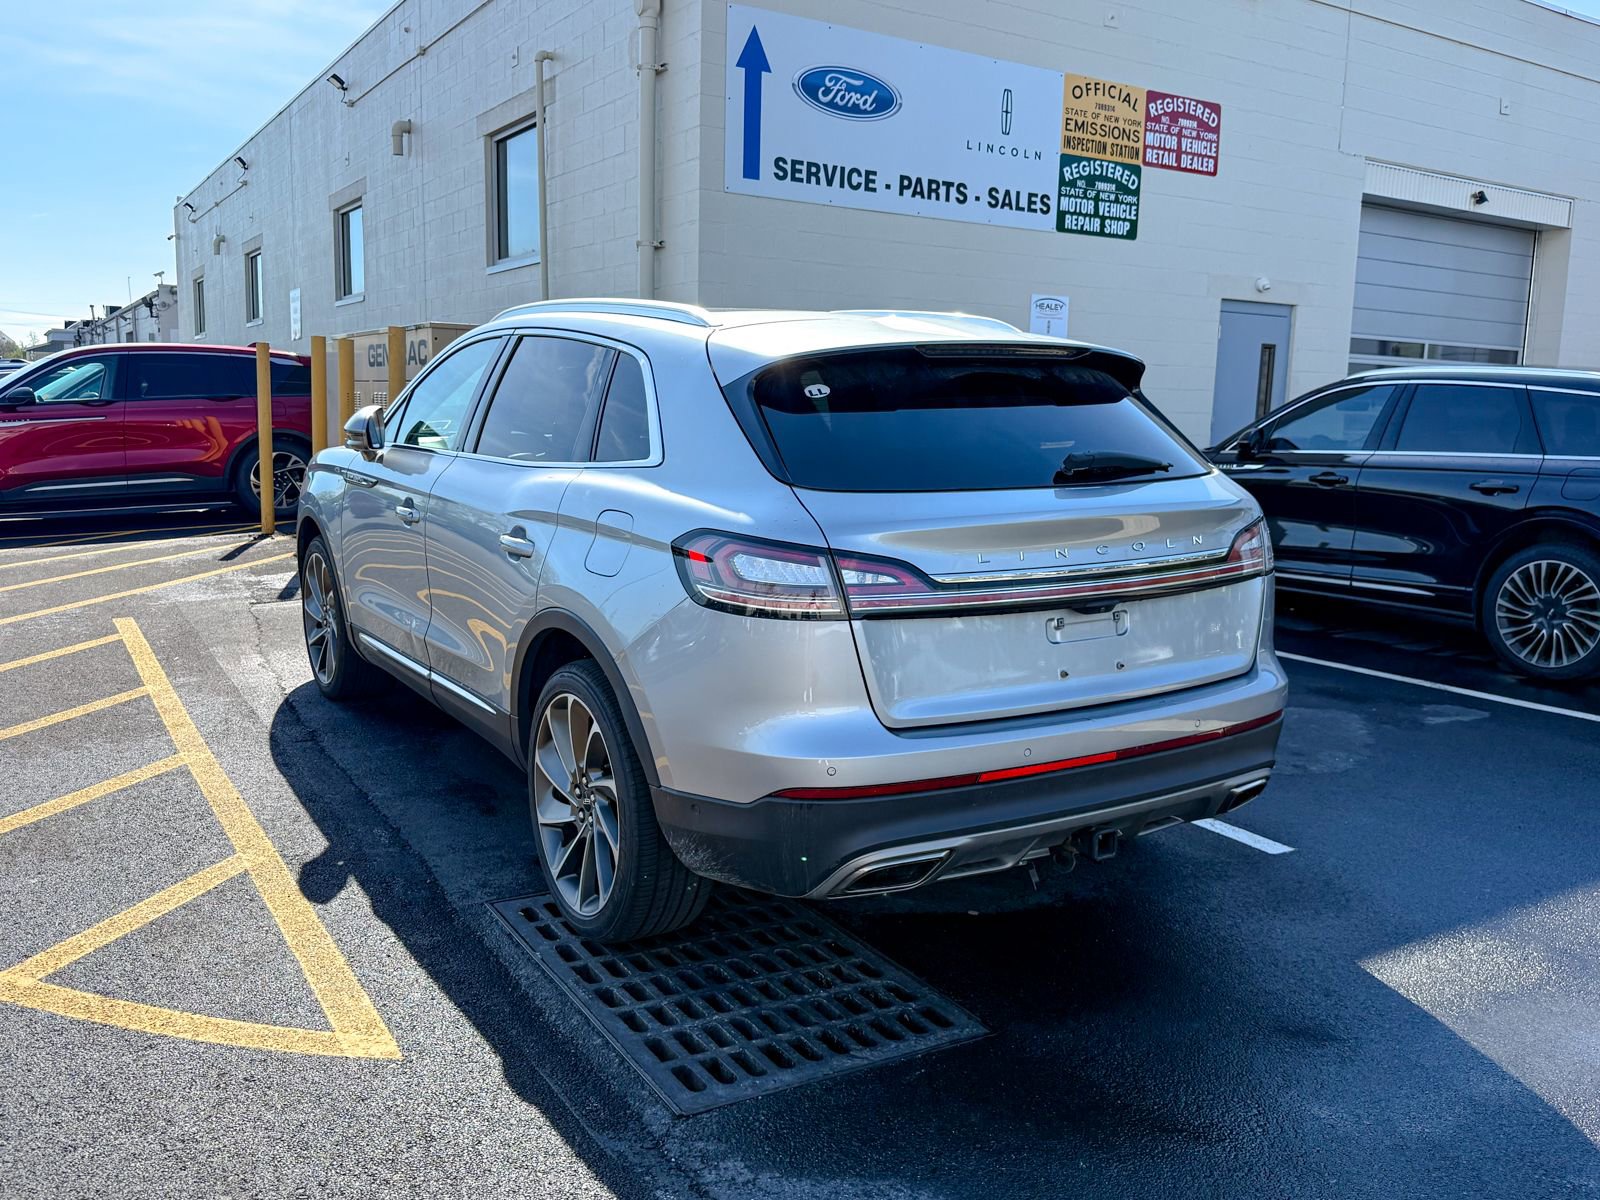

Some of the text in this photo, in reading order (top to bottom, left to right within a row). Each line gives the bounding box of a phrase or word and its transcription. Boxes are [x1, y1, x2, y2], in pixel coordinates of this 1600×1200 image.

[816, 72, 878, 113] Ford
[1073, 82, 1139, 113] OFFICIAL
[1065, 107, 1142, 128] STATE OF NEW YORK
[1149, 97, 1218, 128] REGISTERED
[1066, 118, 1141, 144] EMISSIONS
[1146, 131, 1217, 157] MOTOR VEHICLE
[1147, 121, 1218, 141] STATE OF NEW YORK
[966, 139, 1043, 162] LINCOLN
[1064, 135, 1140, 161] INSPECTION STATION
[1147, 148, 1215, 173] RETAIL DEALER
[773, 156, 878, 193] SERVICE
[898, 174, 968, 205] PARTS
[987, 186, 1052, 216] SALES
[1064, 160, 1139, 190] REGISTERED
[1061, 186, 1138, 205] STATE OF NEW YORK
[1061, 196, 1137, 220] MOTOR VEHICLE
[1066, 215, 1131, 236] REPAIR SHOP
[1035, 302, 1064, 311] HEALEY
[368, 339, 428, 368] GENAC
[977, 535, 1203, 564] LINCOLN
